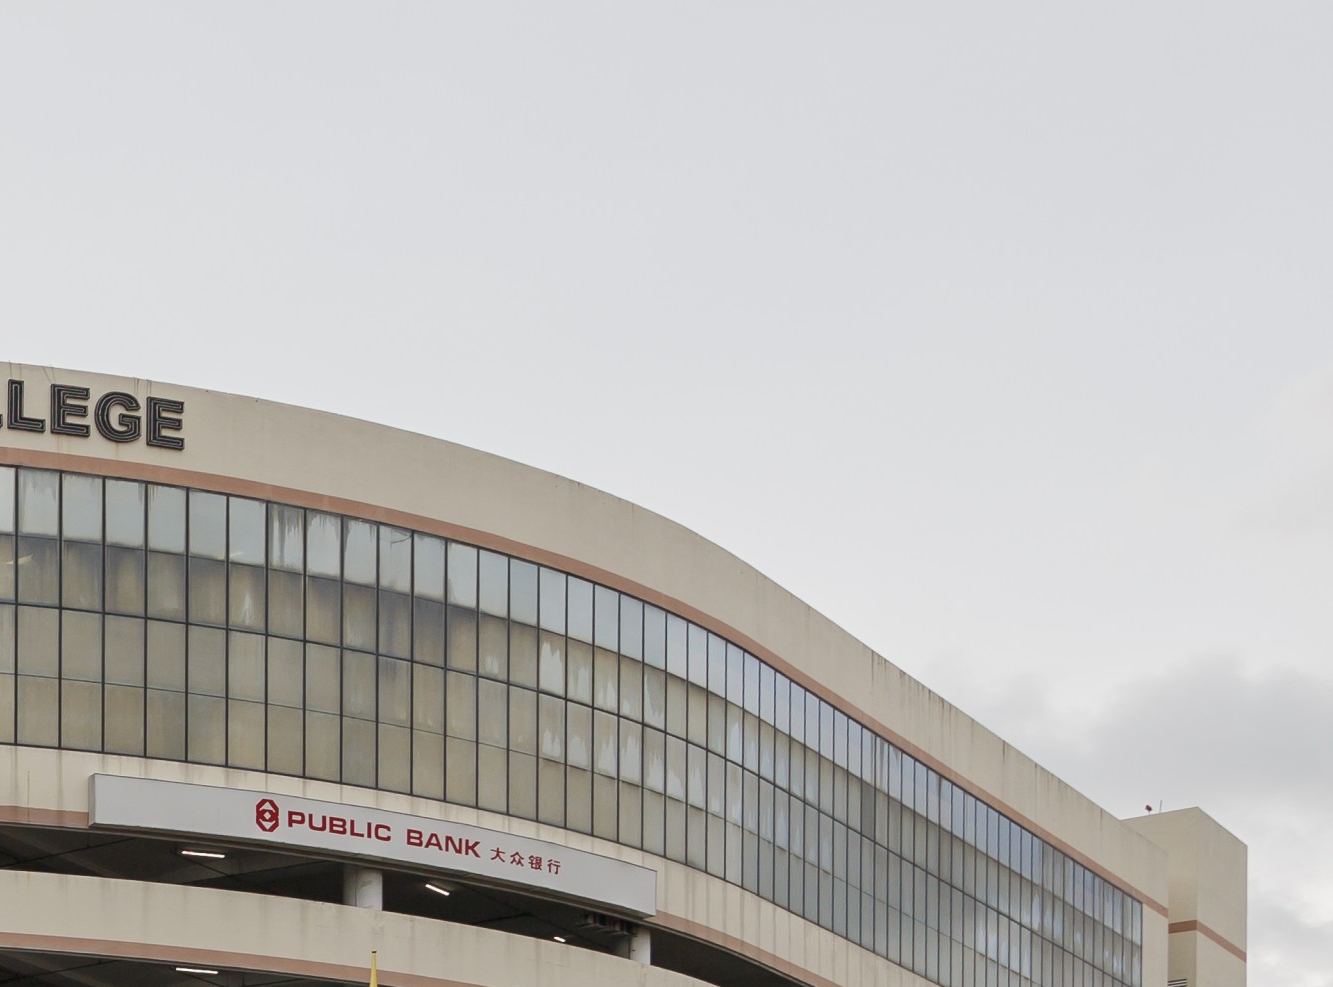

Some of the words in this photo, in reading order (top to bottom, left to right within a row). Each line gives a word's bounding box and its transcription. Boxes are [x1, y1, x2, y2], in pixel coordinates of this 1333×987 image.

[287, 808, 392, 843] PUBLIC
[406, 828, 482, 859] BANK
[489, 846, 563, 876] 大众银行
